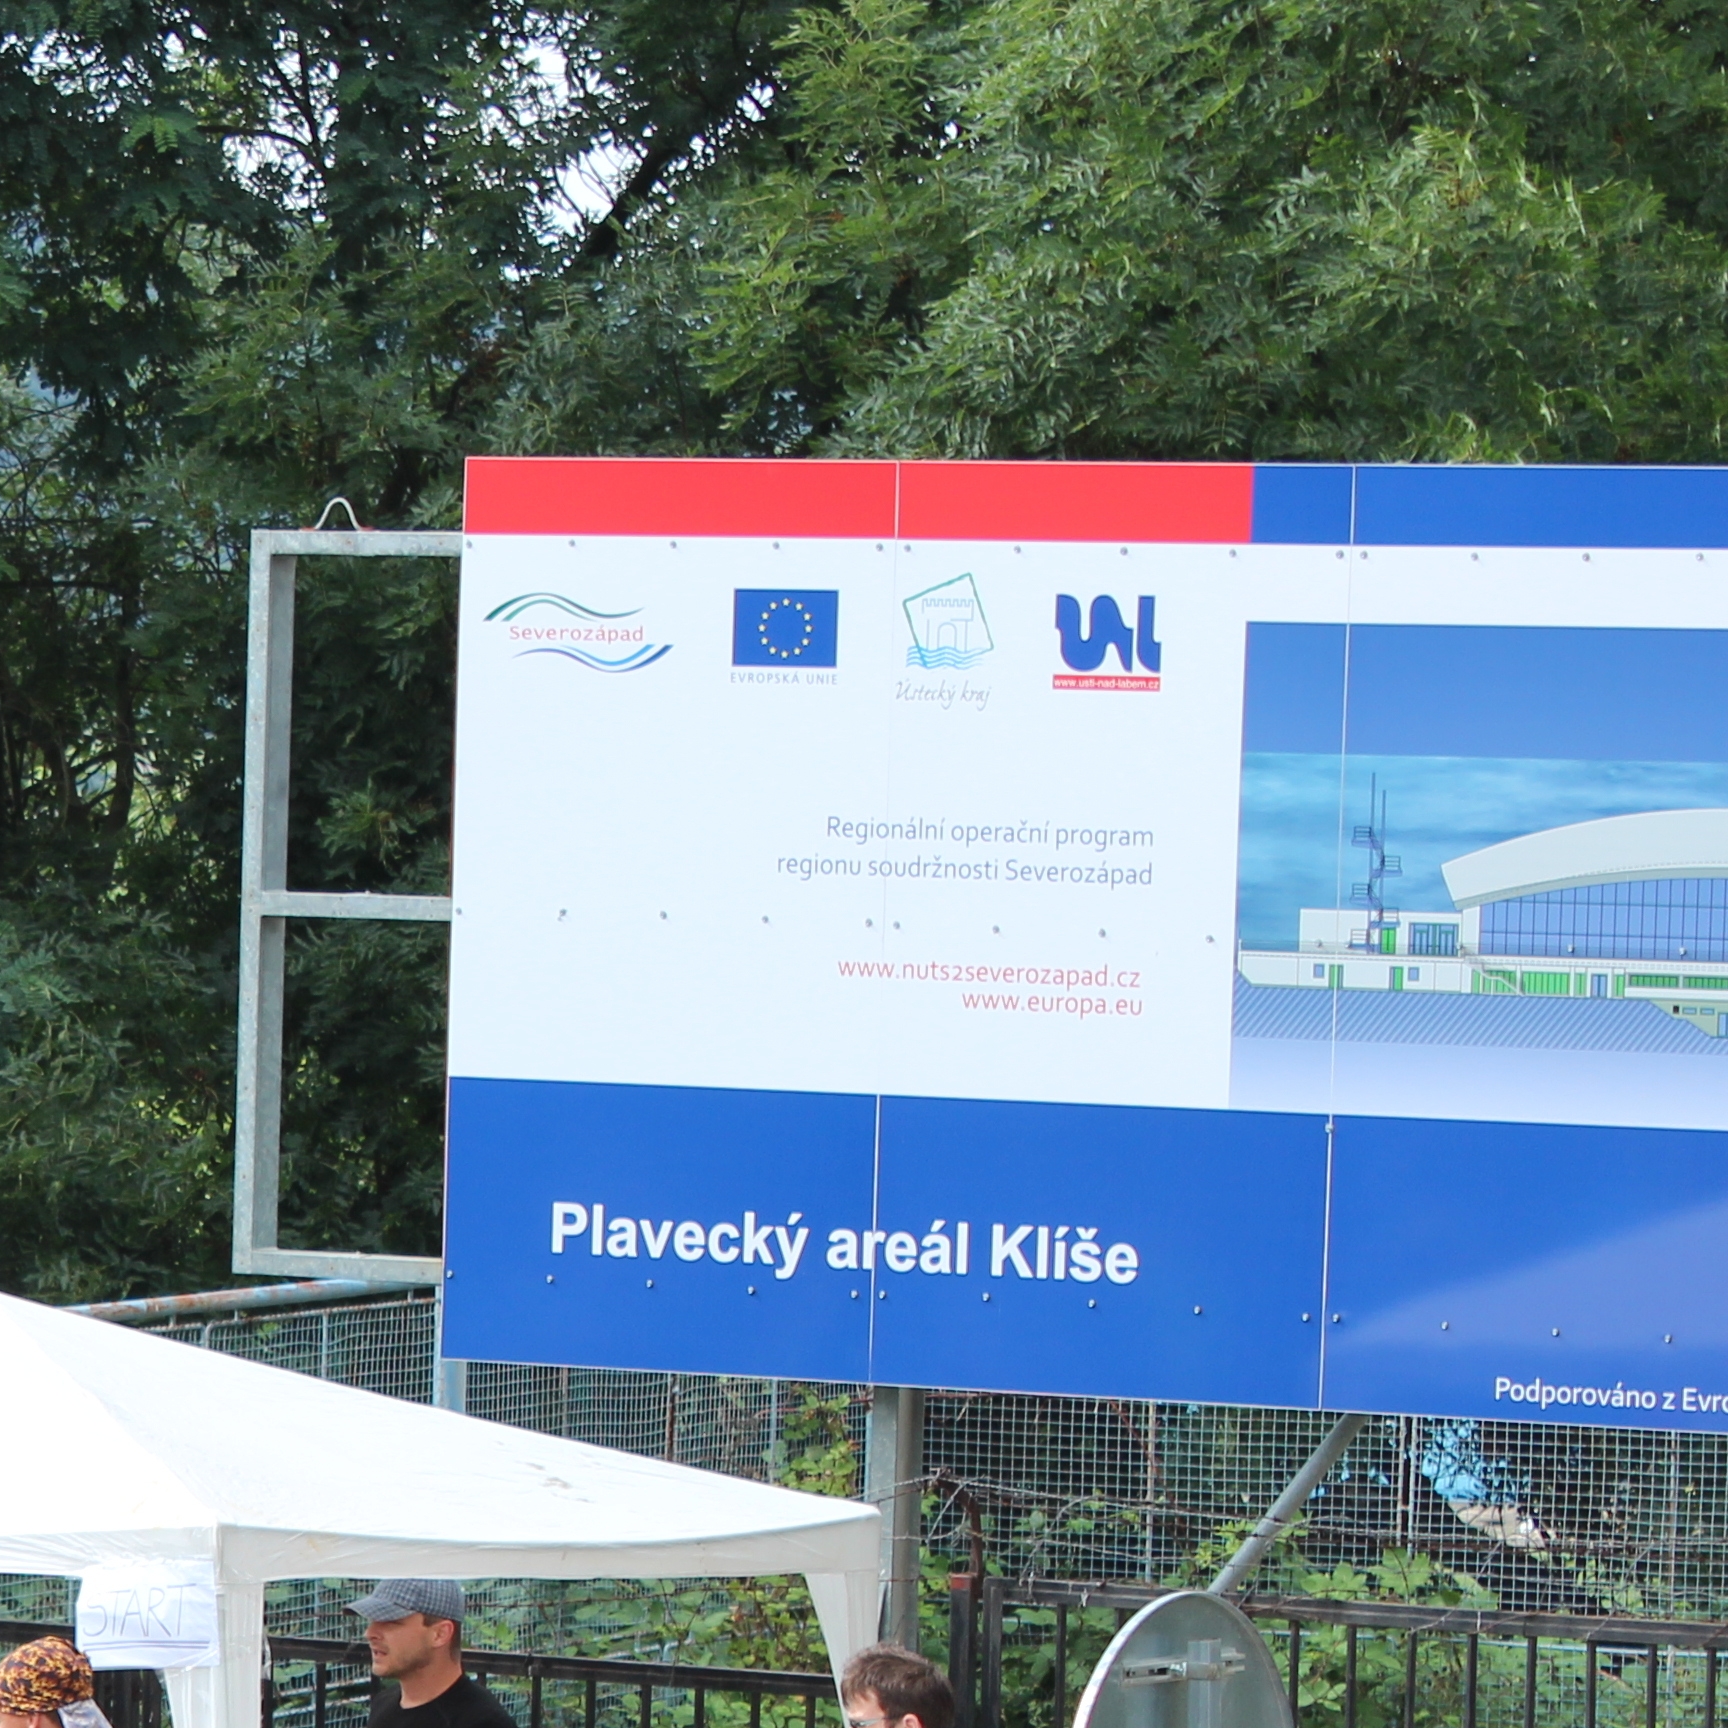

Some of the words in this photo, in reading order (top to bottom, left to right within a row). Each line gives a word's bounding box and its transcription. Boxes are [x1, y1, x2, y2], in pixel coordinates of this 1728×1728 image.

[509, 624, 644, 644] Severozápad
[730, 670, 800, 685] EVROPSKÁ
[806, 672, 838, 686] UNIE
[896, 678, 956, 709] Ústecký
[961, 680, 992, 711] kraj
[826, 815, 946, 845] Regionální
[950, 819, 1049, 848] operační
[1055, 825, 1154, 852] program
[777, 854, 862, 880] regionu
[868, 855, 999, 881] soudržnosti
[1005, 859, 1152, 890] Severozápad
[838, 960, 1140, 991] www.nuts2severozapad.cz
[962, 992, 1143, 1019] www.europa.eu
[551, 1201, 809, 1280] Plavecký
[826, 1220, 968, 1275] areál
[990, 1223, 1139, 1284] Klíše
[1495, 1376, 1656, 1410] Podporováno
[1662, 1391, 1675, 1410] z
[83, 1582, 197, 1637] START
